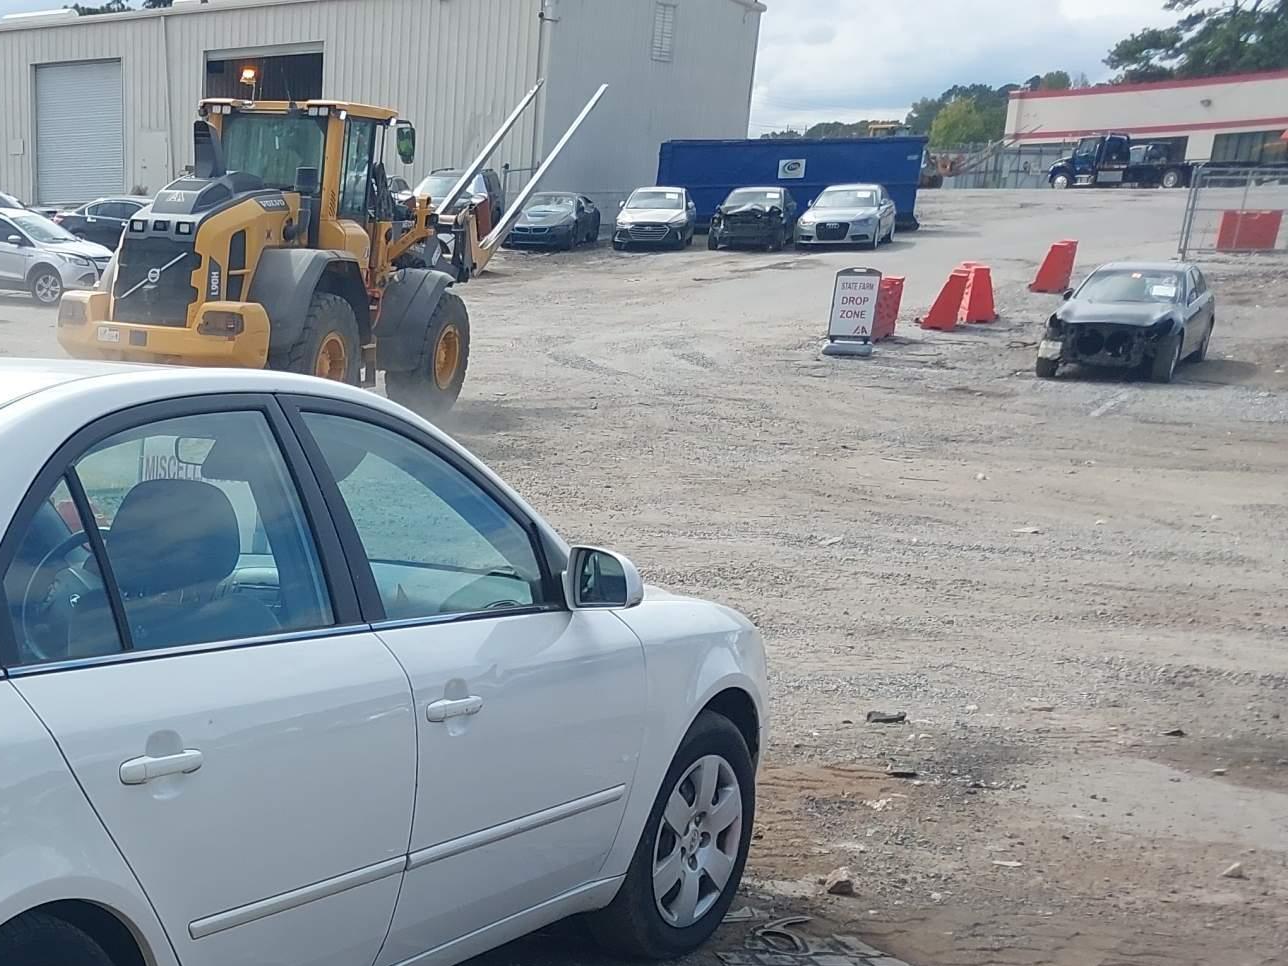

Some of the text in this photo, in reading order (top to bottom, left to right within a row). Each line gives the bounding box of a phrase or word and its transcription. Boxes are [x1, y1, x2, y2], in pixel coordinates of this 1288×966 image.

[259, 199, 286, 208] VOLVO
[211, 271, 219, 296] L90H
[841, 282, 874, 291] STATE FARM
[841, 297, 870, 306] DROP
[839, 310, 866, 319] ZONE
